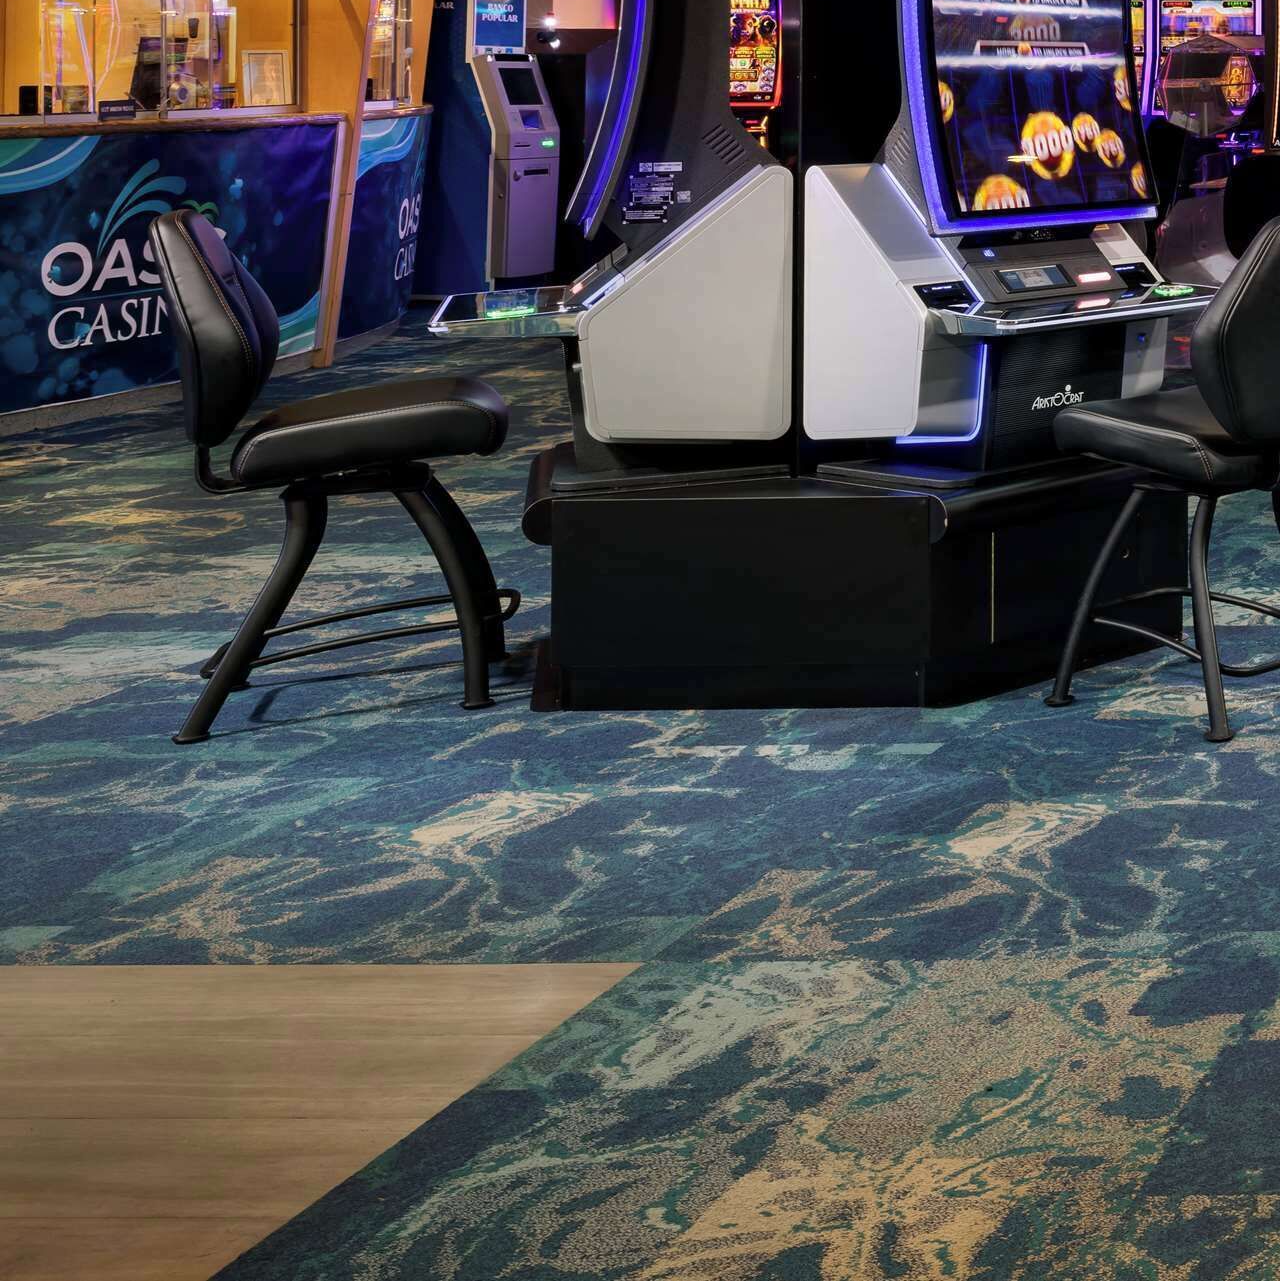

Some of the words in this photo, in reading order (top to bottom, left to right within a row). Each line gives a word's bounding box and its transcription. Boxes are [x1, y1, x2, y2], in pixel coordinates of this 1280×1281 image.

[487, 3, 514, 13] BANCO
[482, 13, 518, 23] POPULAR
[1032, 384, 1084, 411] ARISTOCRAT
